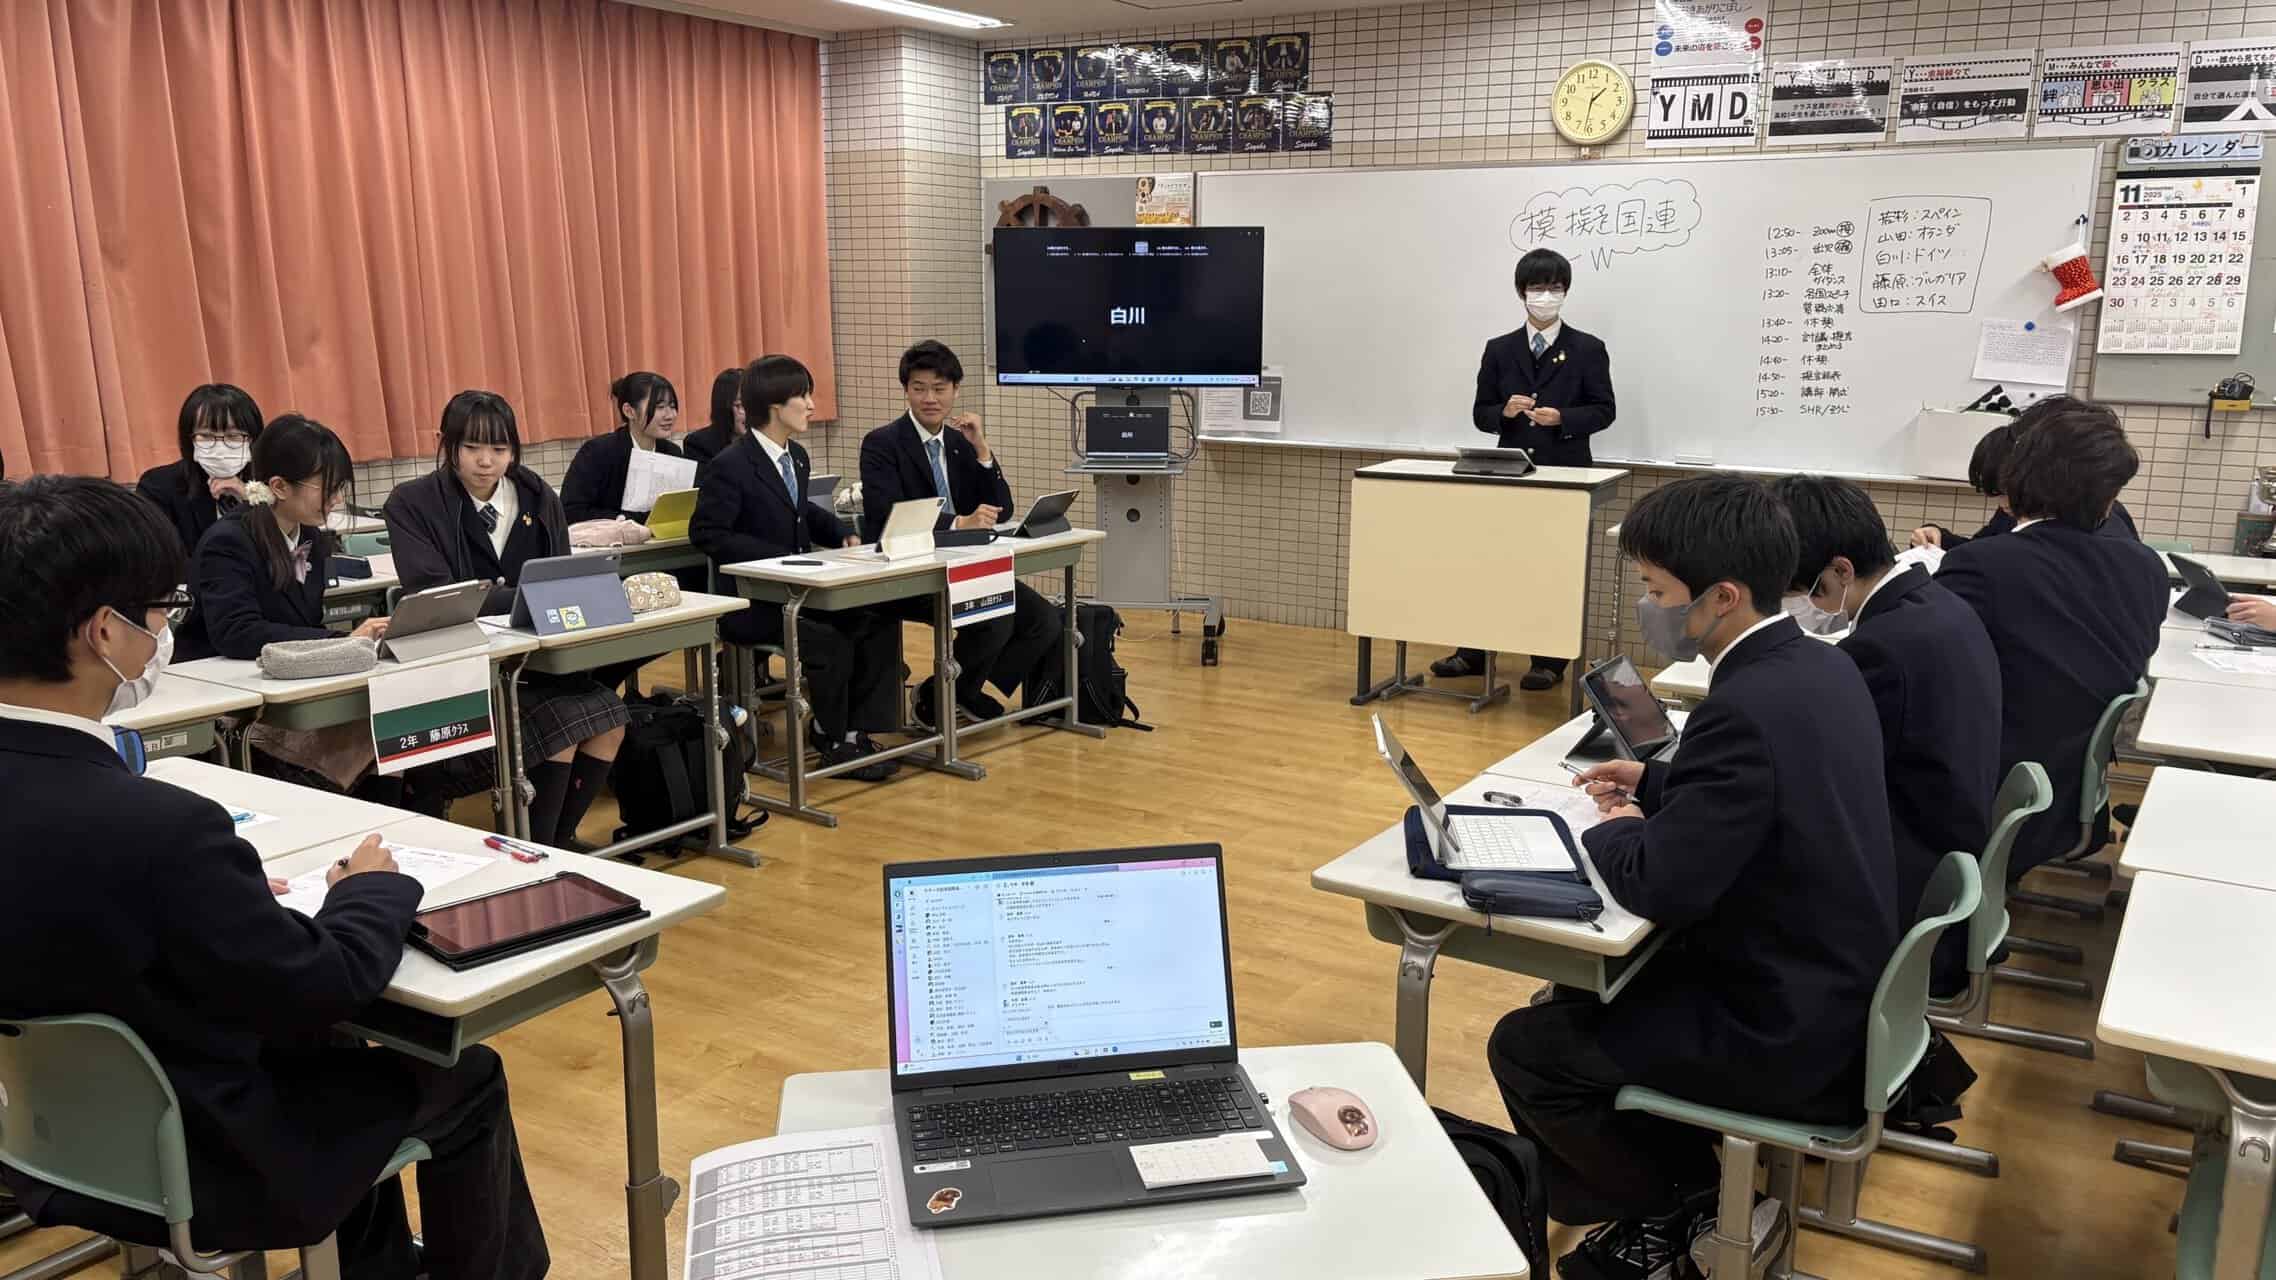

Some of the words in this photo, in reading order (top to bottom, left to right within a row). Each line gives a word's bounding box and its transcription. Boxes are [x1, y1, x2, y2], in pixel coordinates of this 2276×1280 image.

[1577, 72, 1585, 84] 11
[1589, 69, 1598, 79] 12
[1868, 70, 1875, 80] D
[1614, 82, 1620, 92] 2
[2091, 79, 2124, 89] 思い出
[2137, 78, 2169, 87] クラス
[1567, 84, 1576, 94] 10
[1562, 98, 1568, 107] 9
[1616, 96, 1622, 106] 3
[1660, 94, 1677, 122] Y
[1691, 92, 1714, 121] M
[1729, 91, 1748, 120] D
[1565, 112, 1572, 120] 8
[1610, 111, 1616, 120] 4
[1576, 120, 1582, 130] 7
[1586, 123, 1592, 134] 6
[1600, 120, 1606, 130] 5
[2161, 138, 2258, 157] カレンダー
[2119, 184, 2141, 203] 11
[2240, 187, 2246, 197] 1
[2123, 212, 2130, 221] 2
[2142, 211, 2149, 220] 3
[2161, 211, 2168, 219] 4
[2179, 210, 2187, 219] 5
[2199, 210, 2206, 219] 6
[2218, 210, 2225, 218] 7
[2238, 209, 2245, 218] 8
[1521, 199, 1681, 243] 模擬国連
[2121, 234, 2128, 242] 9
[2137, 233, 2150, 242] 10
[2157, 233, 2167, 242] 11
[2175, 232, 2188, 241] 12
[2194, 232, 2207, 241] 13
[2213, 232, 2226, 241] 14
[2232, 231, 2246, 240] 15
[2116, 255, 2129, 264] 16
[2134, 255, 2148, 264] 17
[2153, 255, 2167, 264] 18
[2172, 255, 2185, 263] 19
[2190, 254, 2205, 263] 20
[2209, 254, 2223, 263] 21
[2228, 254, 2244, 263] 22
[2112, 277, 2126, 286] 23
[2131, 277, 2145, 286] 24
[2150, 277, 2164, 286] 25
[2168, 276, 2183, 285] 26
[2187, 276, 2201, 285] 27
[2206, 276, 2221, 285] 28
[2225, 276, 2241, 285] 29
[2110, 299, 2124, 308] 30
[2134, 298, 2138, 307] 1
[2152, 298, 2158, 307] 2
[2170, 298, 2177, 307] 3
[2188, 298, 2195, 307] 4
[2208, 298, 2215, 307] 5
[2227, 298, 2234, 307] 6
[1110, 306, 1145, 325] 白川
[400, 735, 419, 749] 2年
[429, 723, 470, 743] 藤原クラス
